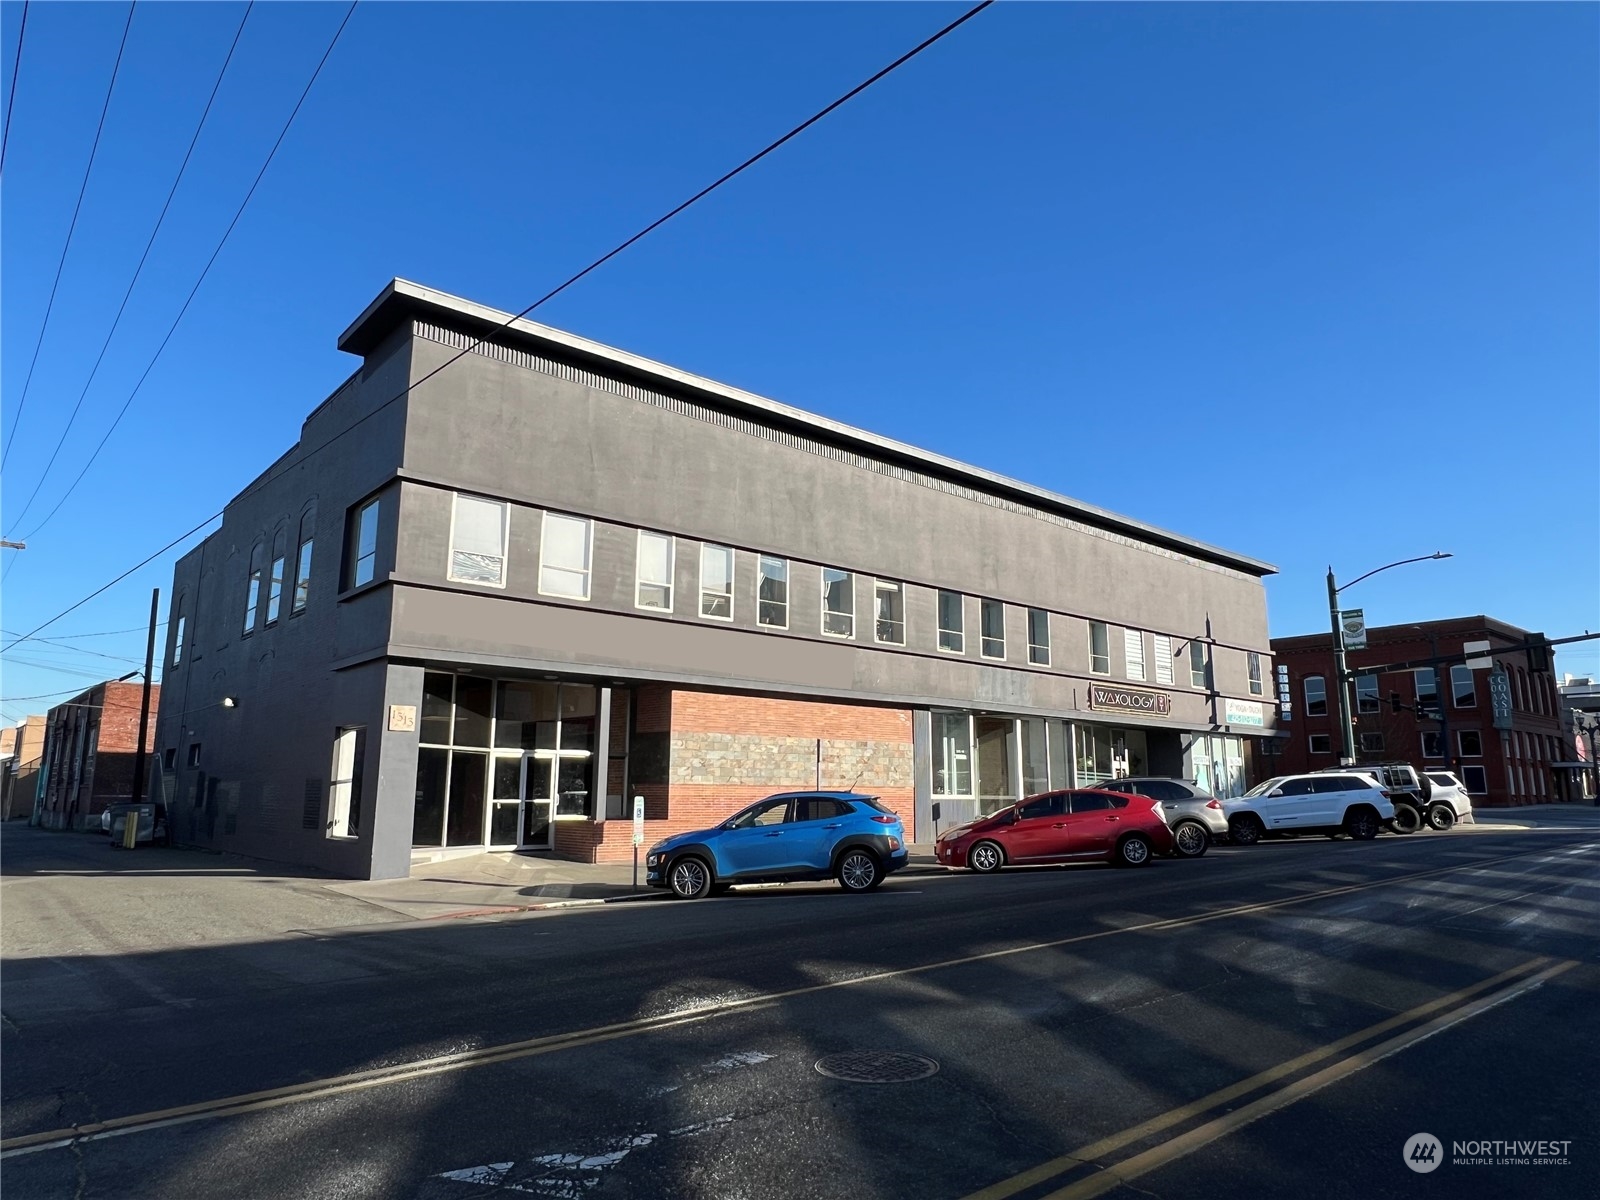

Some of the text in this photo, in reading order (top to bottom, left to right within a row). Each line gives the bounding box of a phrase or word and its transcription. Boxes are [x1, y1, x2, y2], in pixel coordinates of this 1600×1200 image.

[1095, 691, 1154, 708] WAXOLOGY
[1497, 676, 1509, 717] COAST
[392, 709, 414, 727] 1513
